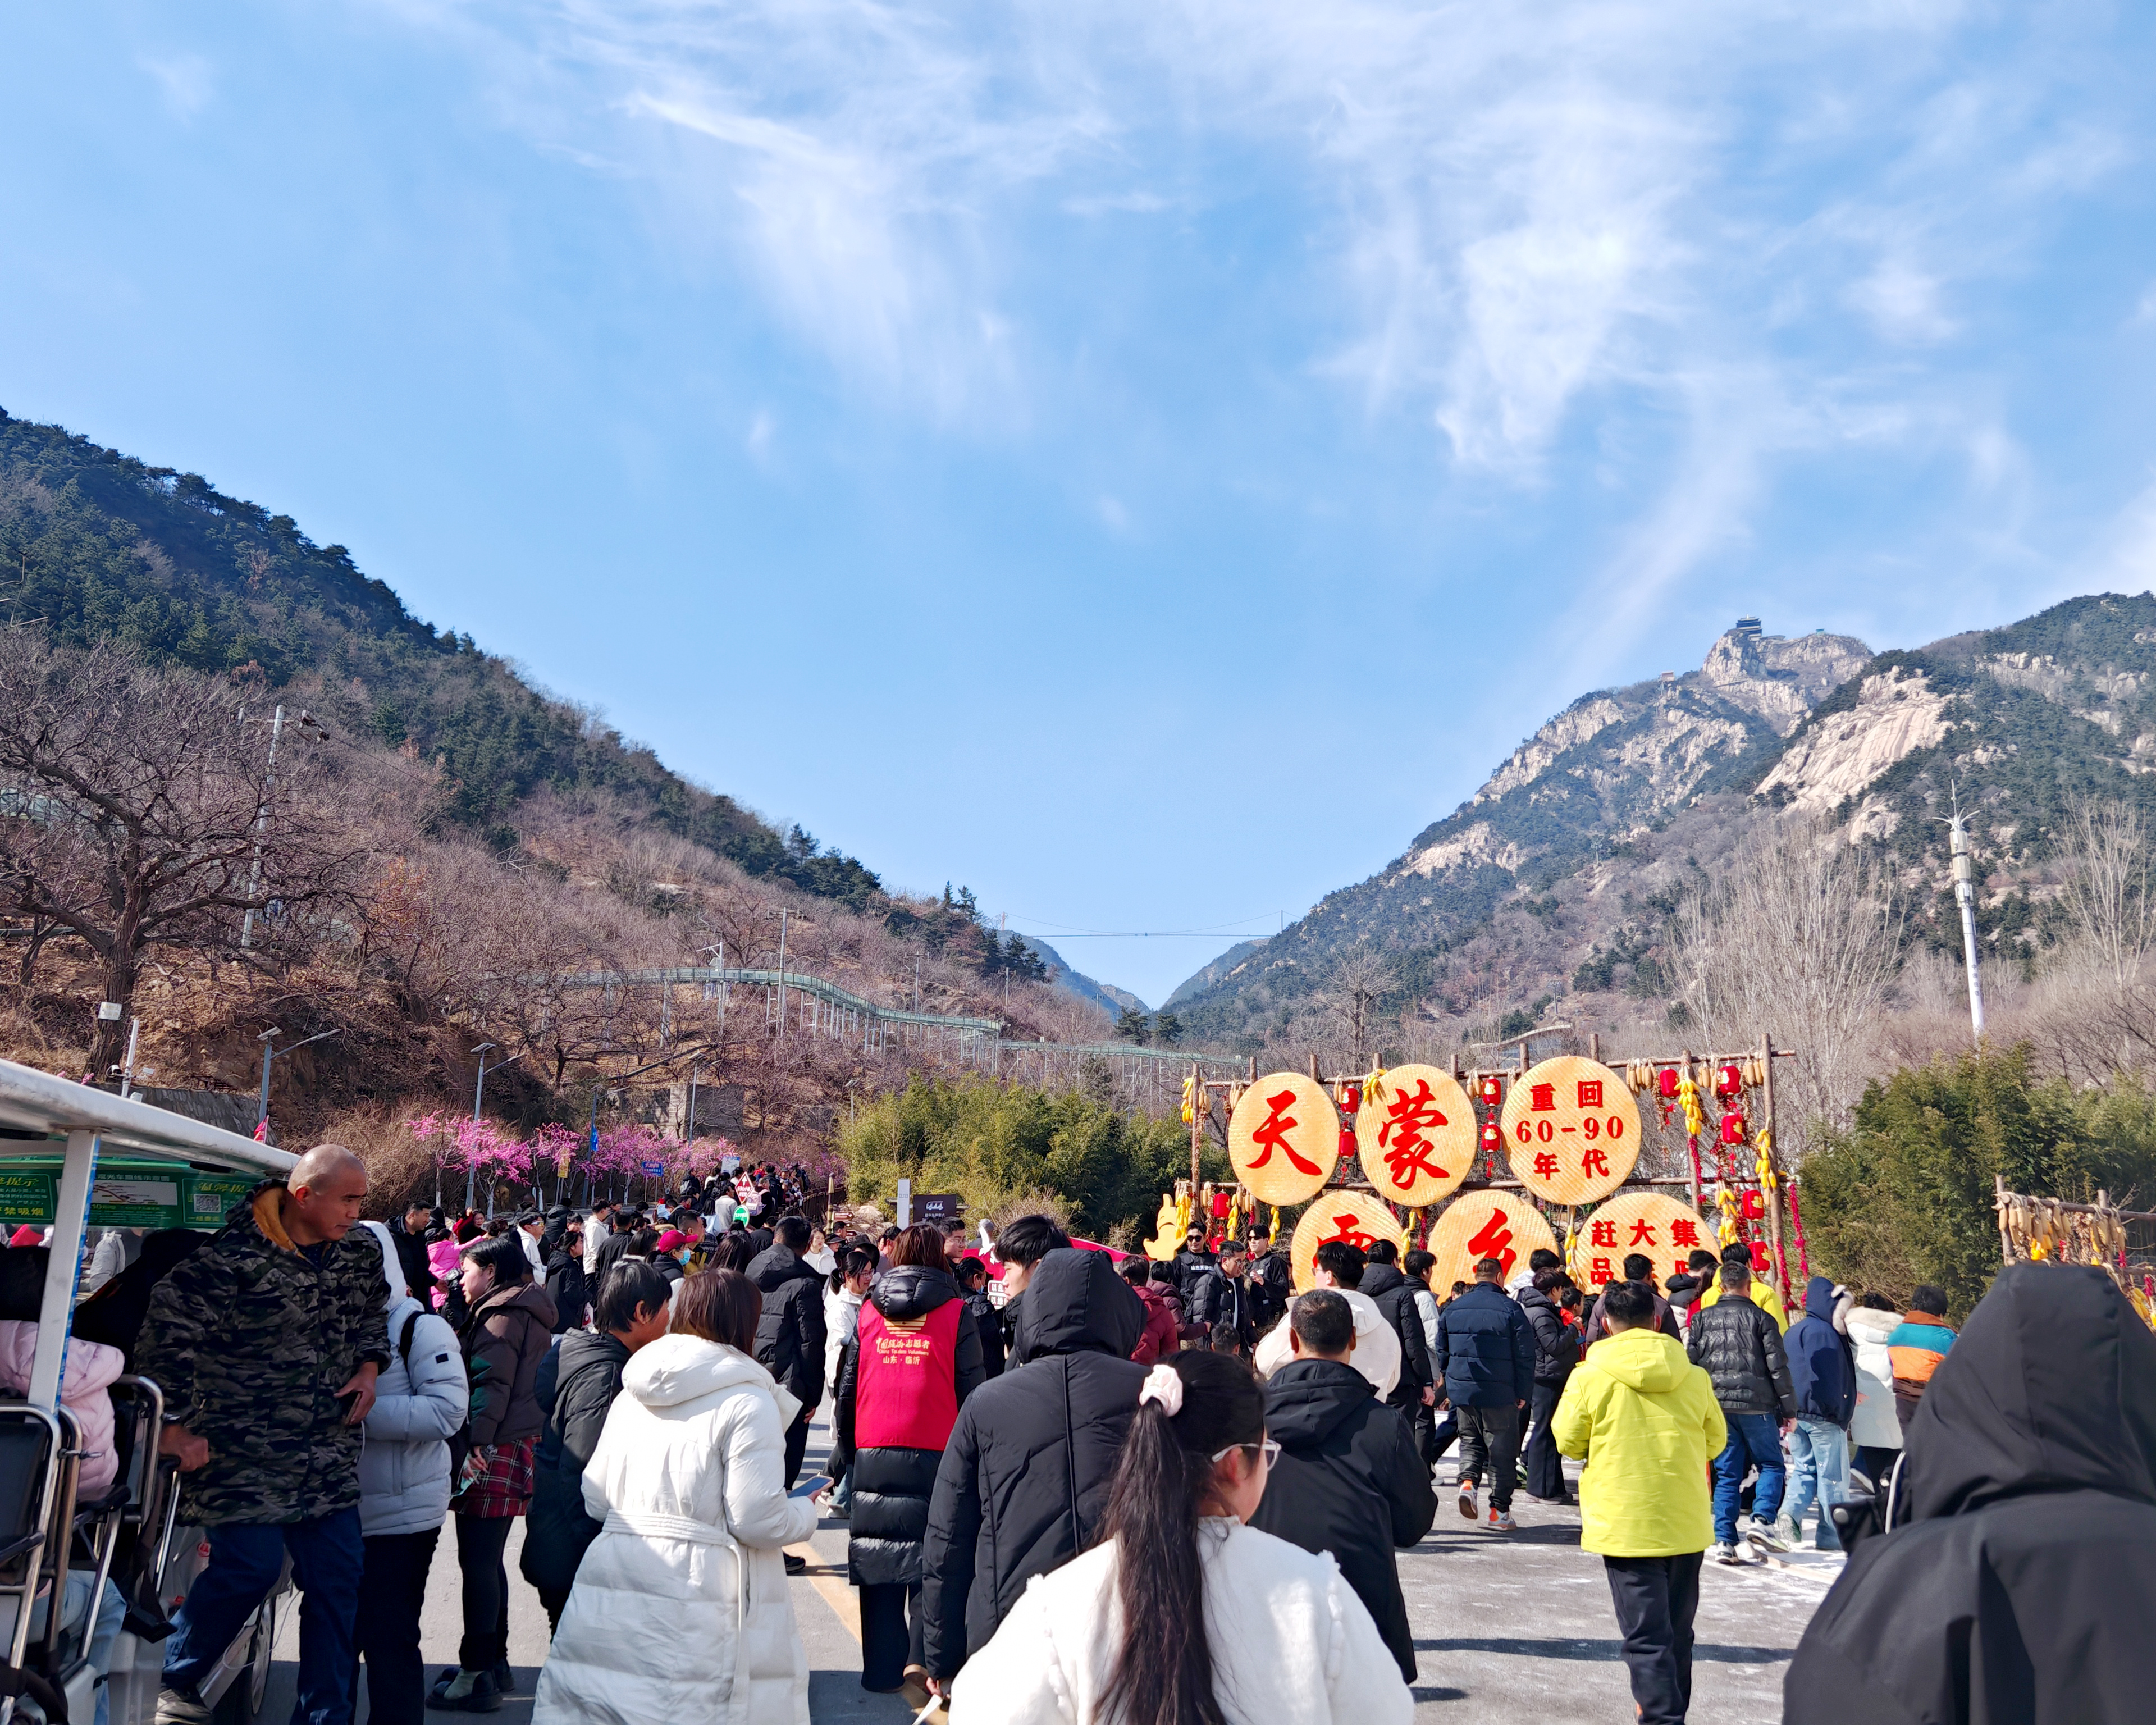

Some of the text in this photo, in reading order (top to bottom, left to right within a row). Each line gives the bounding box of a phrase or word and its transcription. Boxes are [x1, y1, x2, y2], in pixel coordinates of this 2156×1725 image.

[1530, 1080, 1603, 1111] 重回
[1246, 1079, 1450, 1190] 天 蒙
[1516, 1116, 1623, 1143] 60-90
[1534, 1149, 1609, 1180] 年代
[1592, 1219, 1700, 1247] 赶大集
